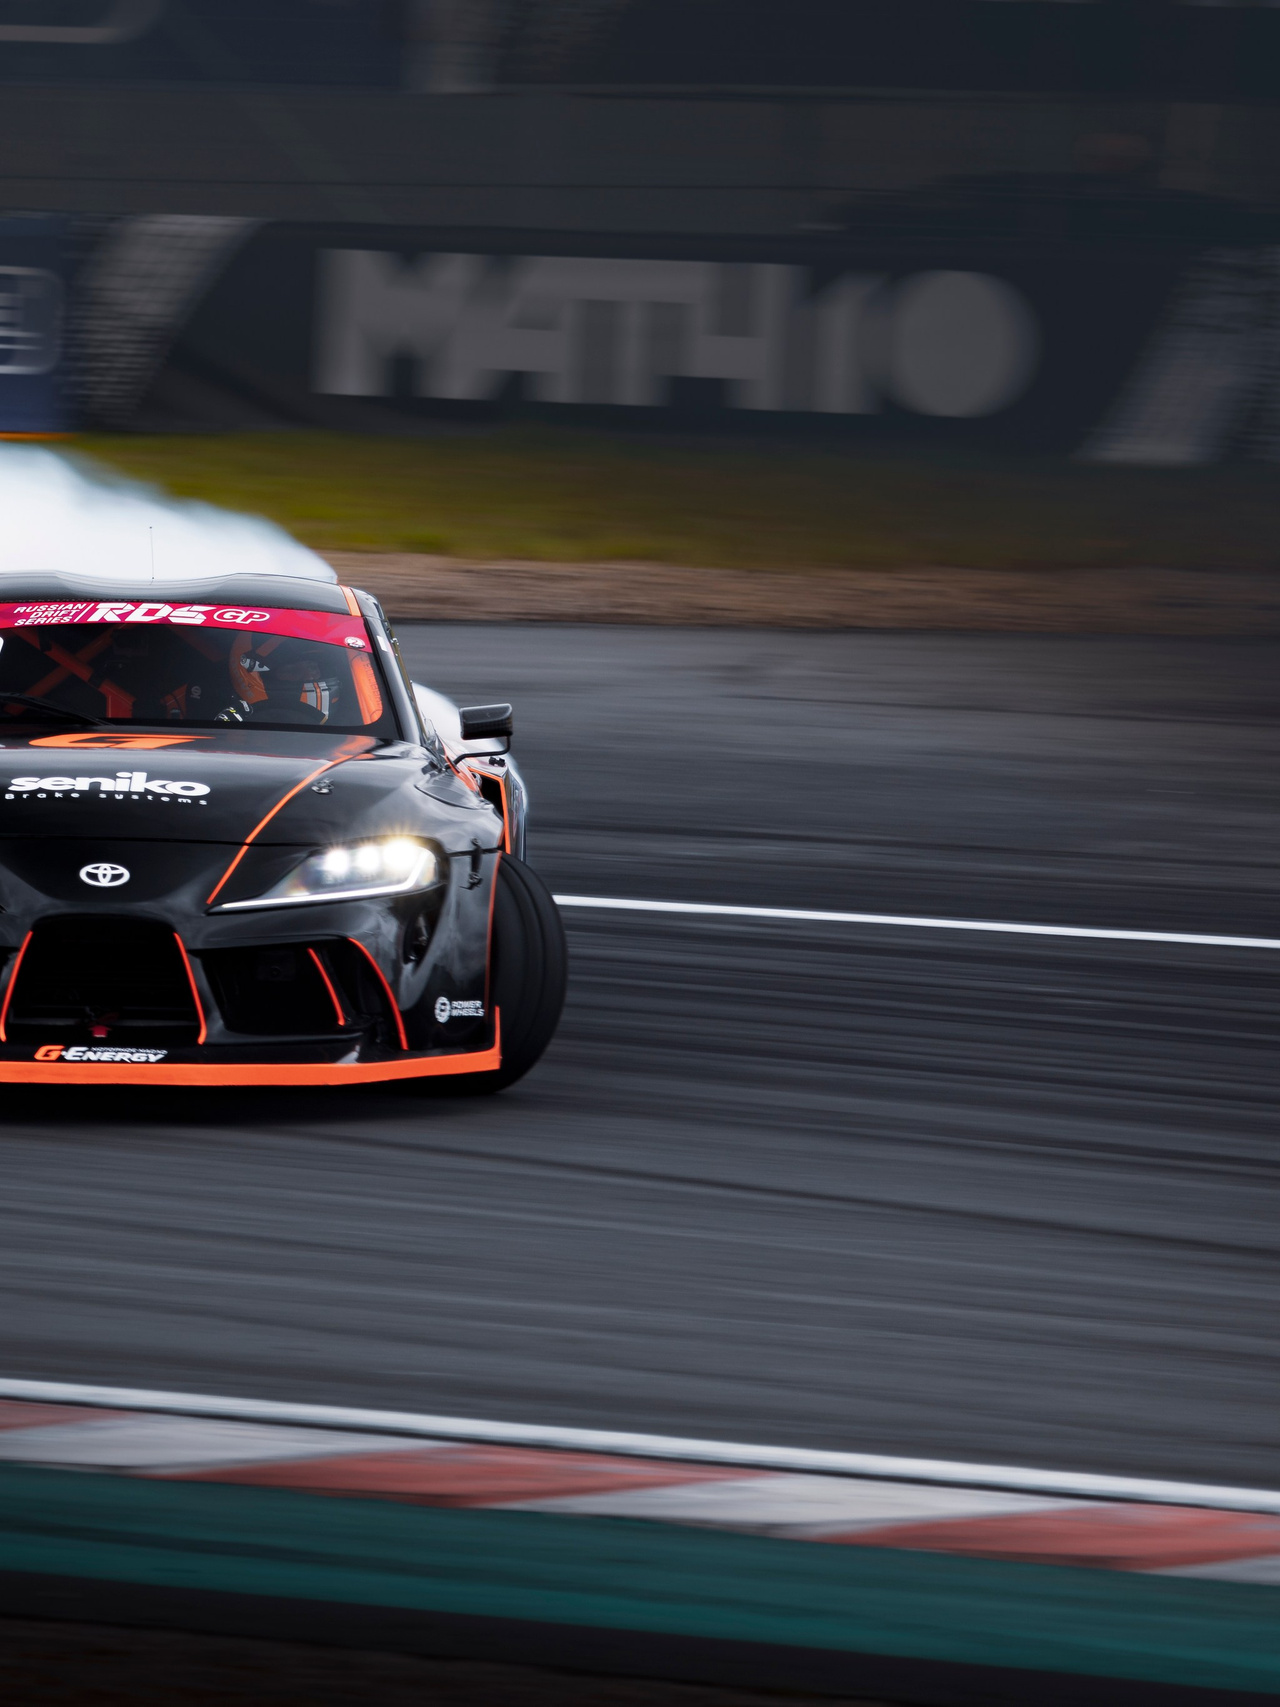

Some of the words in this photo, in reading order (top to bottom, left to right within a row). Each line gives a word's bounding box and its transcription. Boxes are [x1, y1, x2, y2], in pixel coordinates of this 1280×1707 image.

[13, 603, 87, 613] RUSSIAN
[86, 602, 217, 625] RDS
[213, 608, 270, 624] GP
[30, 610, 80, 619] DRIFT
[14, 616, 73, 626] SERIES
[7, 771, 211, 796] seniko
[98, 792, 208, 806] systems
